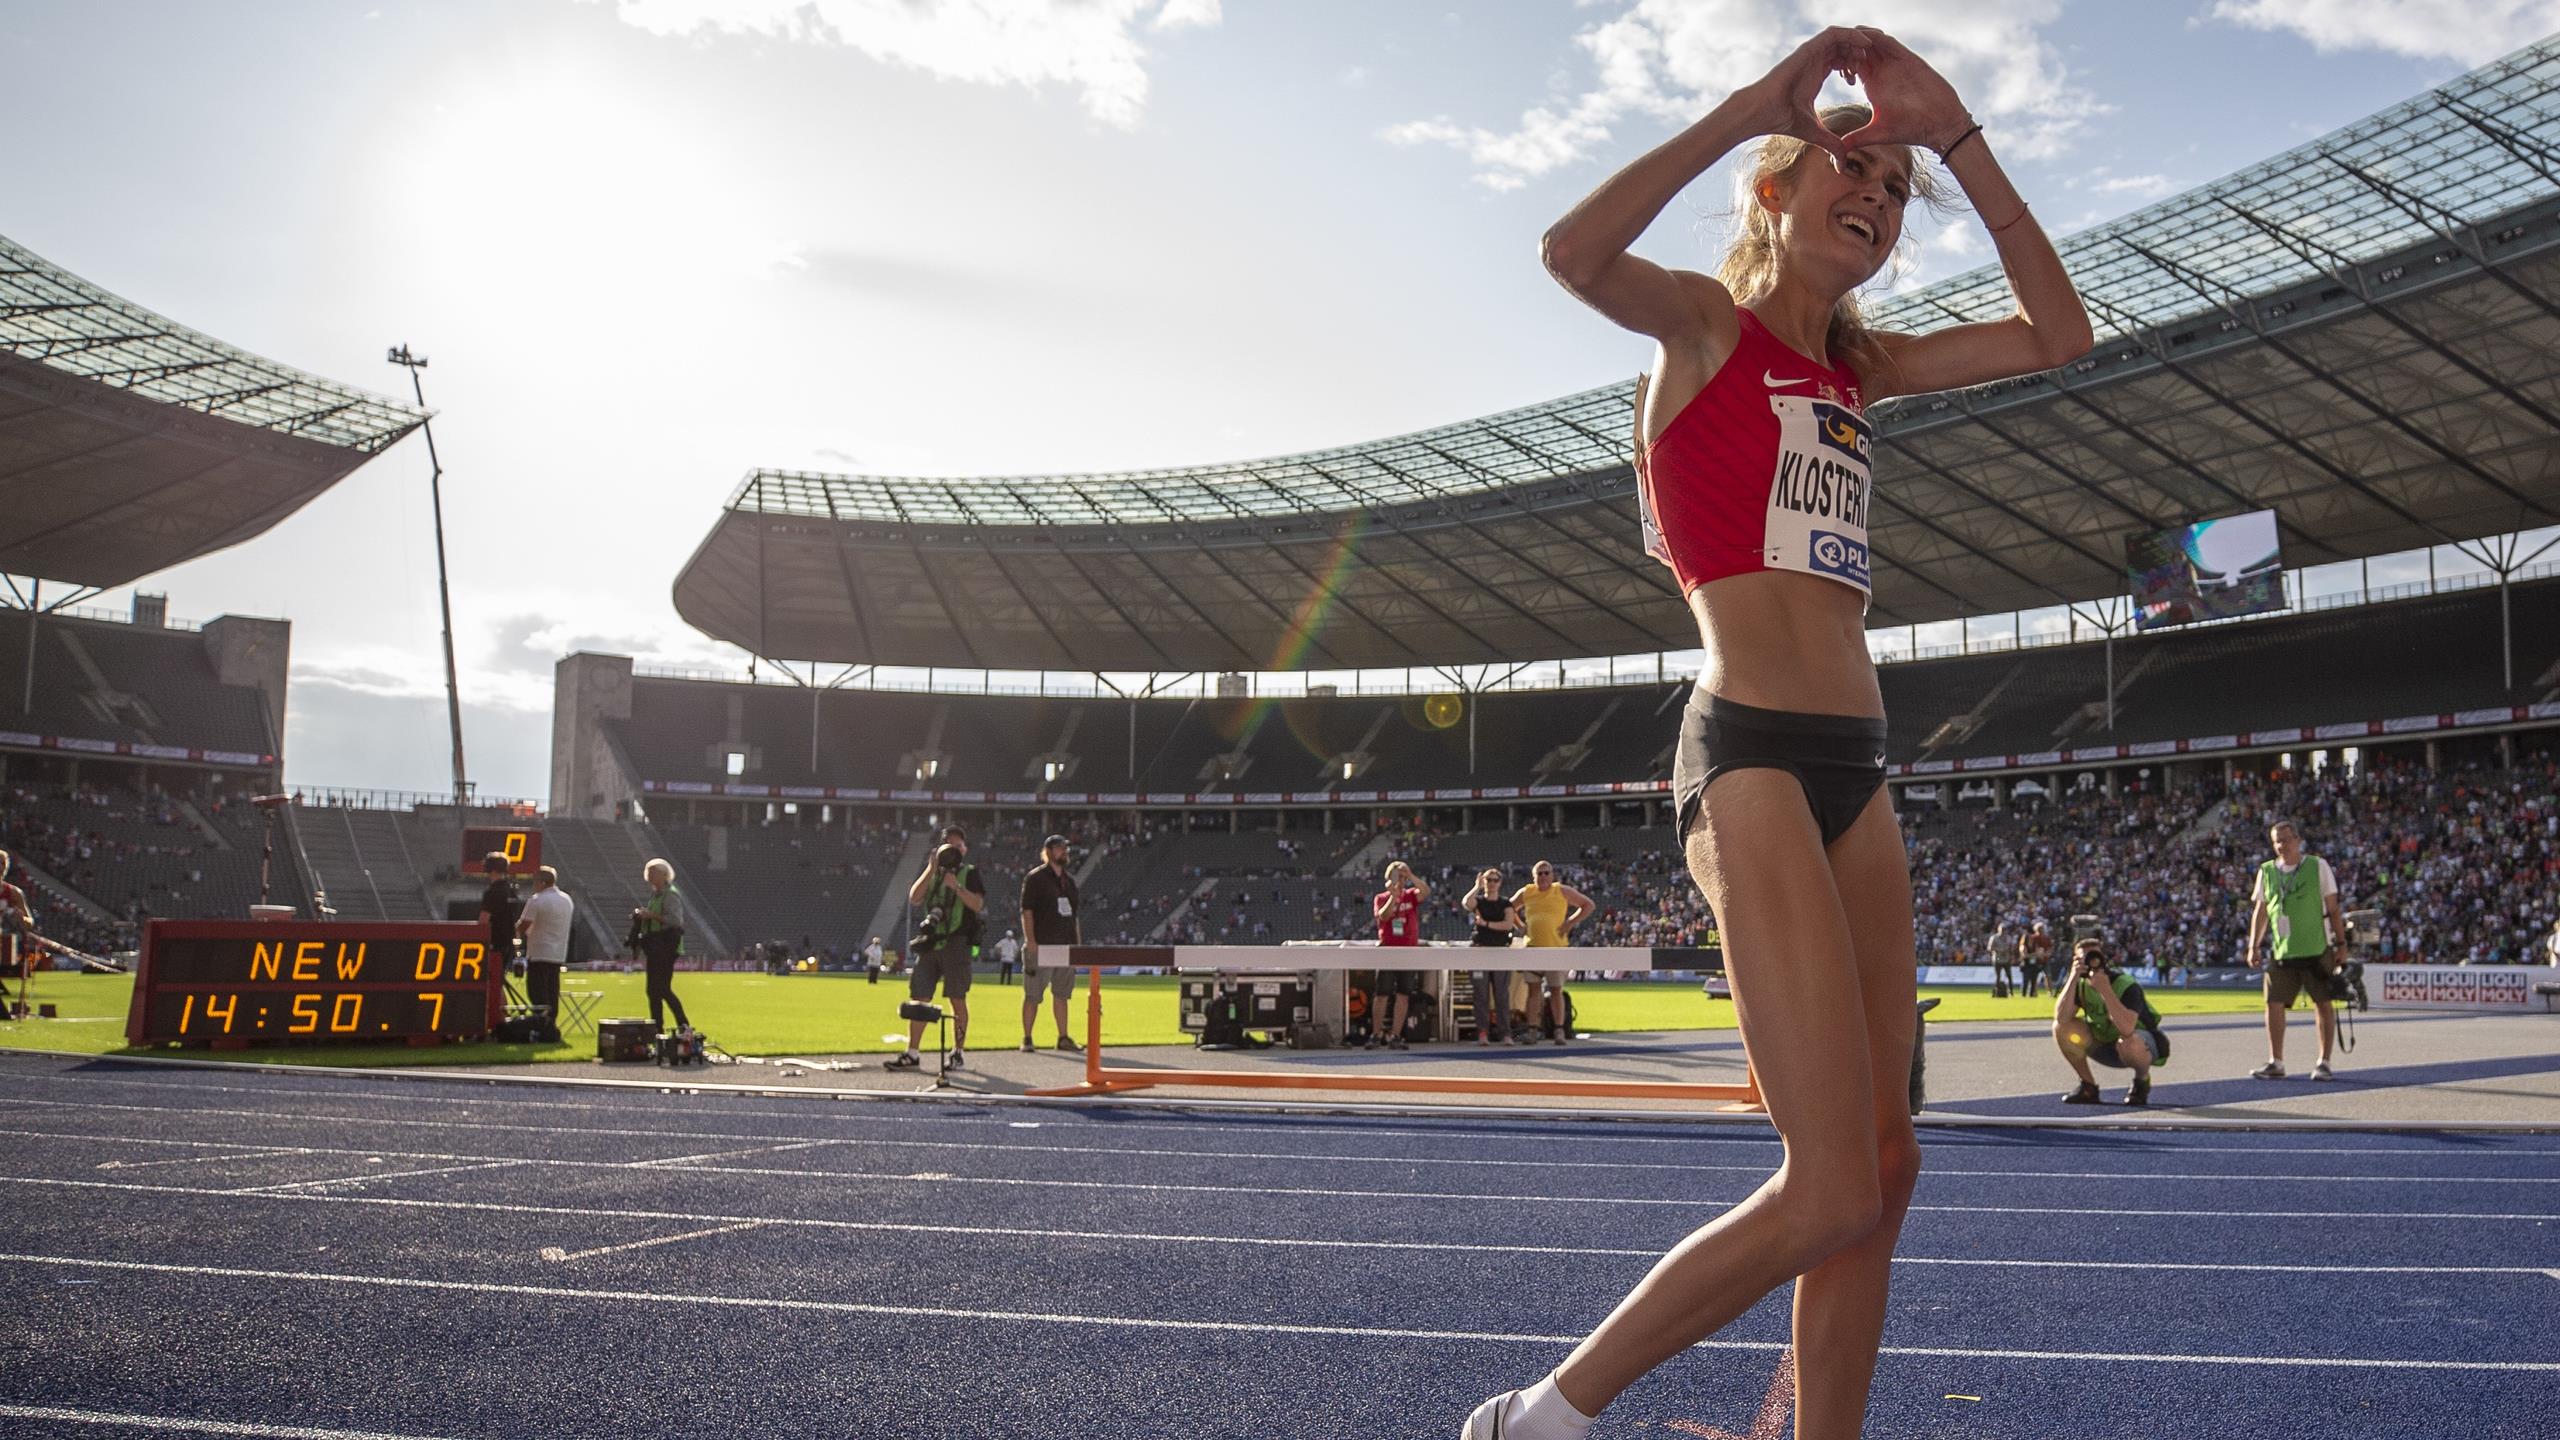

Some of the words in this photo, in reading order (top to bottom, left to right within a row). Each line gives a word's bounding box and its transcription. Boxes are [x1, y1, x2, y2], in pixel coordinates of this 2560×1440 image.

[249, 942, 367, 981] NEW
[414, 942, 486, 981] DR
[2386, 972, 2427, 986] LIQUI
[2433, 973, 2475, 987] LIQUI
[2482, 973, 2525, 987] LIQUI
[2386, 986, 2427, 1000] MOLY
[2433, 987, 2475, 1001] MOLY
[2482, 988, 2526, 1002] MOLY
